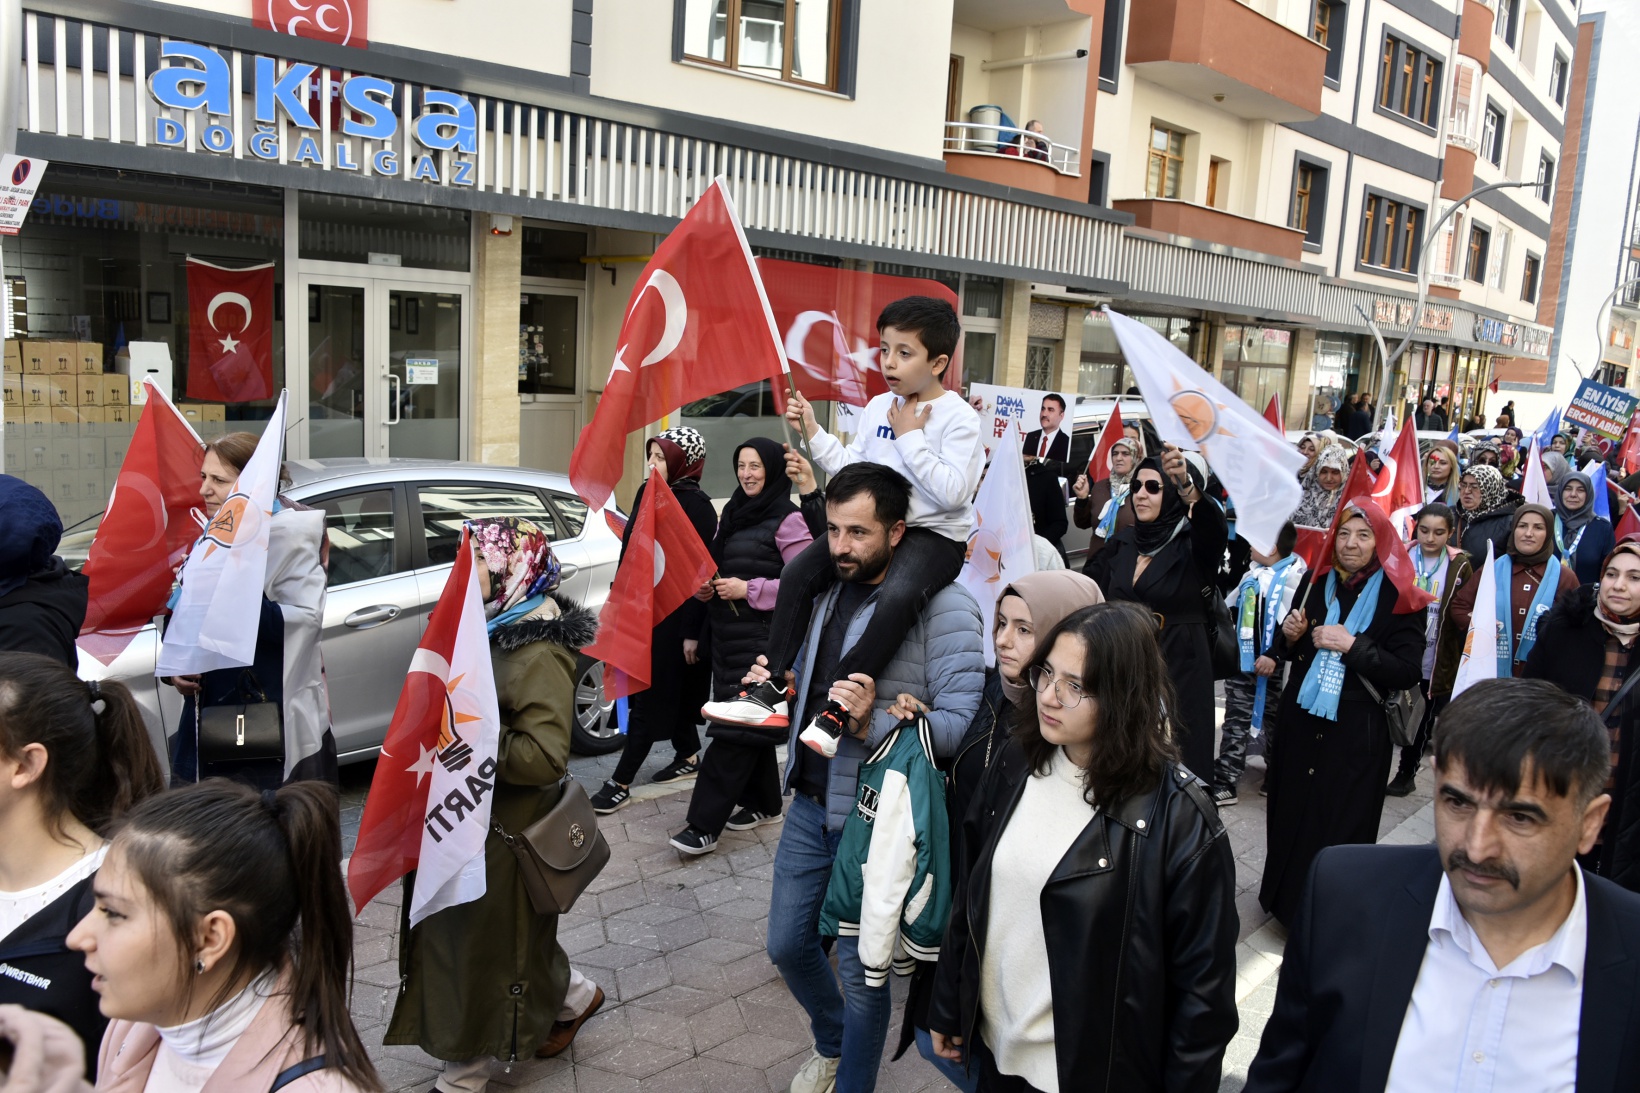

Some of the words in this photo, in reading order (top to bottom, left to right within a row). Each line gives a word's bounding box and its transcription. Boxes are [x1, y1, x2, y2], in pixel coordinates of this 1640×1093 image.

[147, 41, 478, 155] aksa
[154, 116, 475, 186] DOĞALGAZ
[1566, 407, 1600, 427] ERCAN
[1596, 419, 1624, 436] ABİSİ
[1582, 386, 1603, 404] EN
[1600, 391, 1631, 414] İYİSİ
